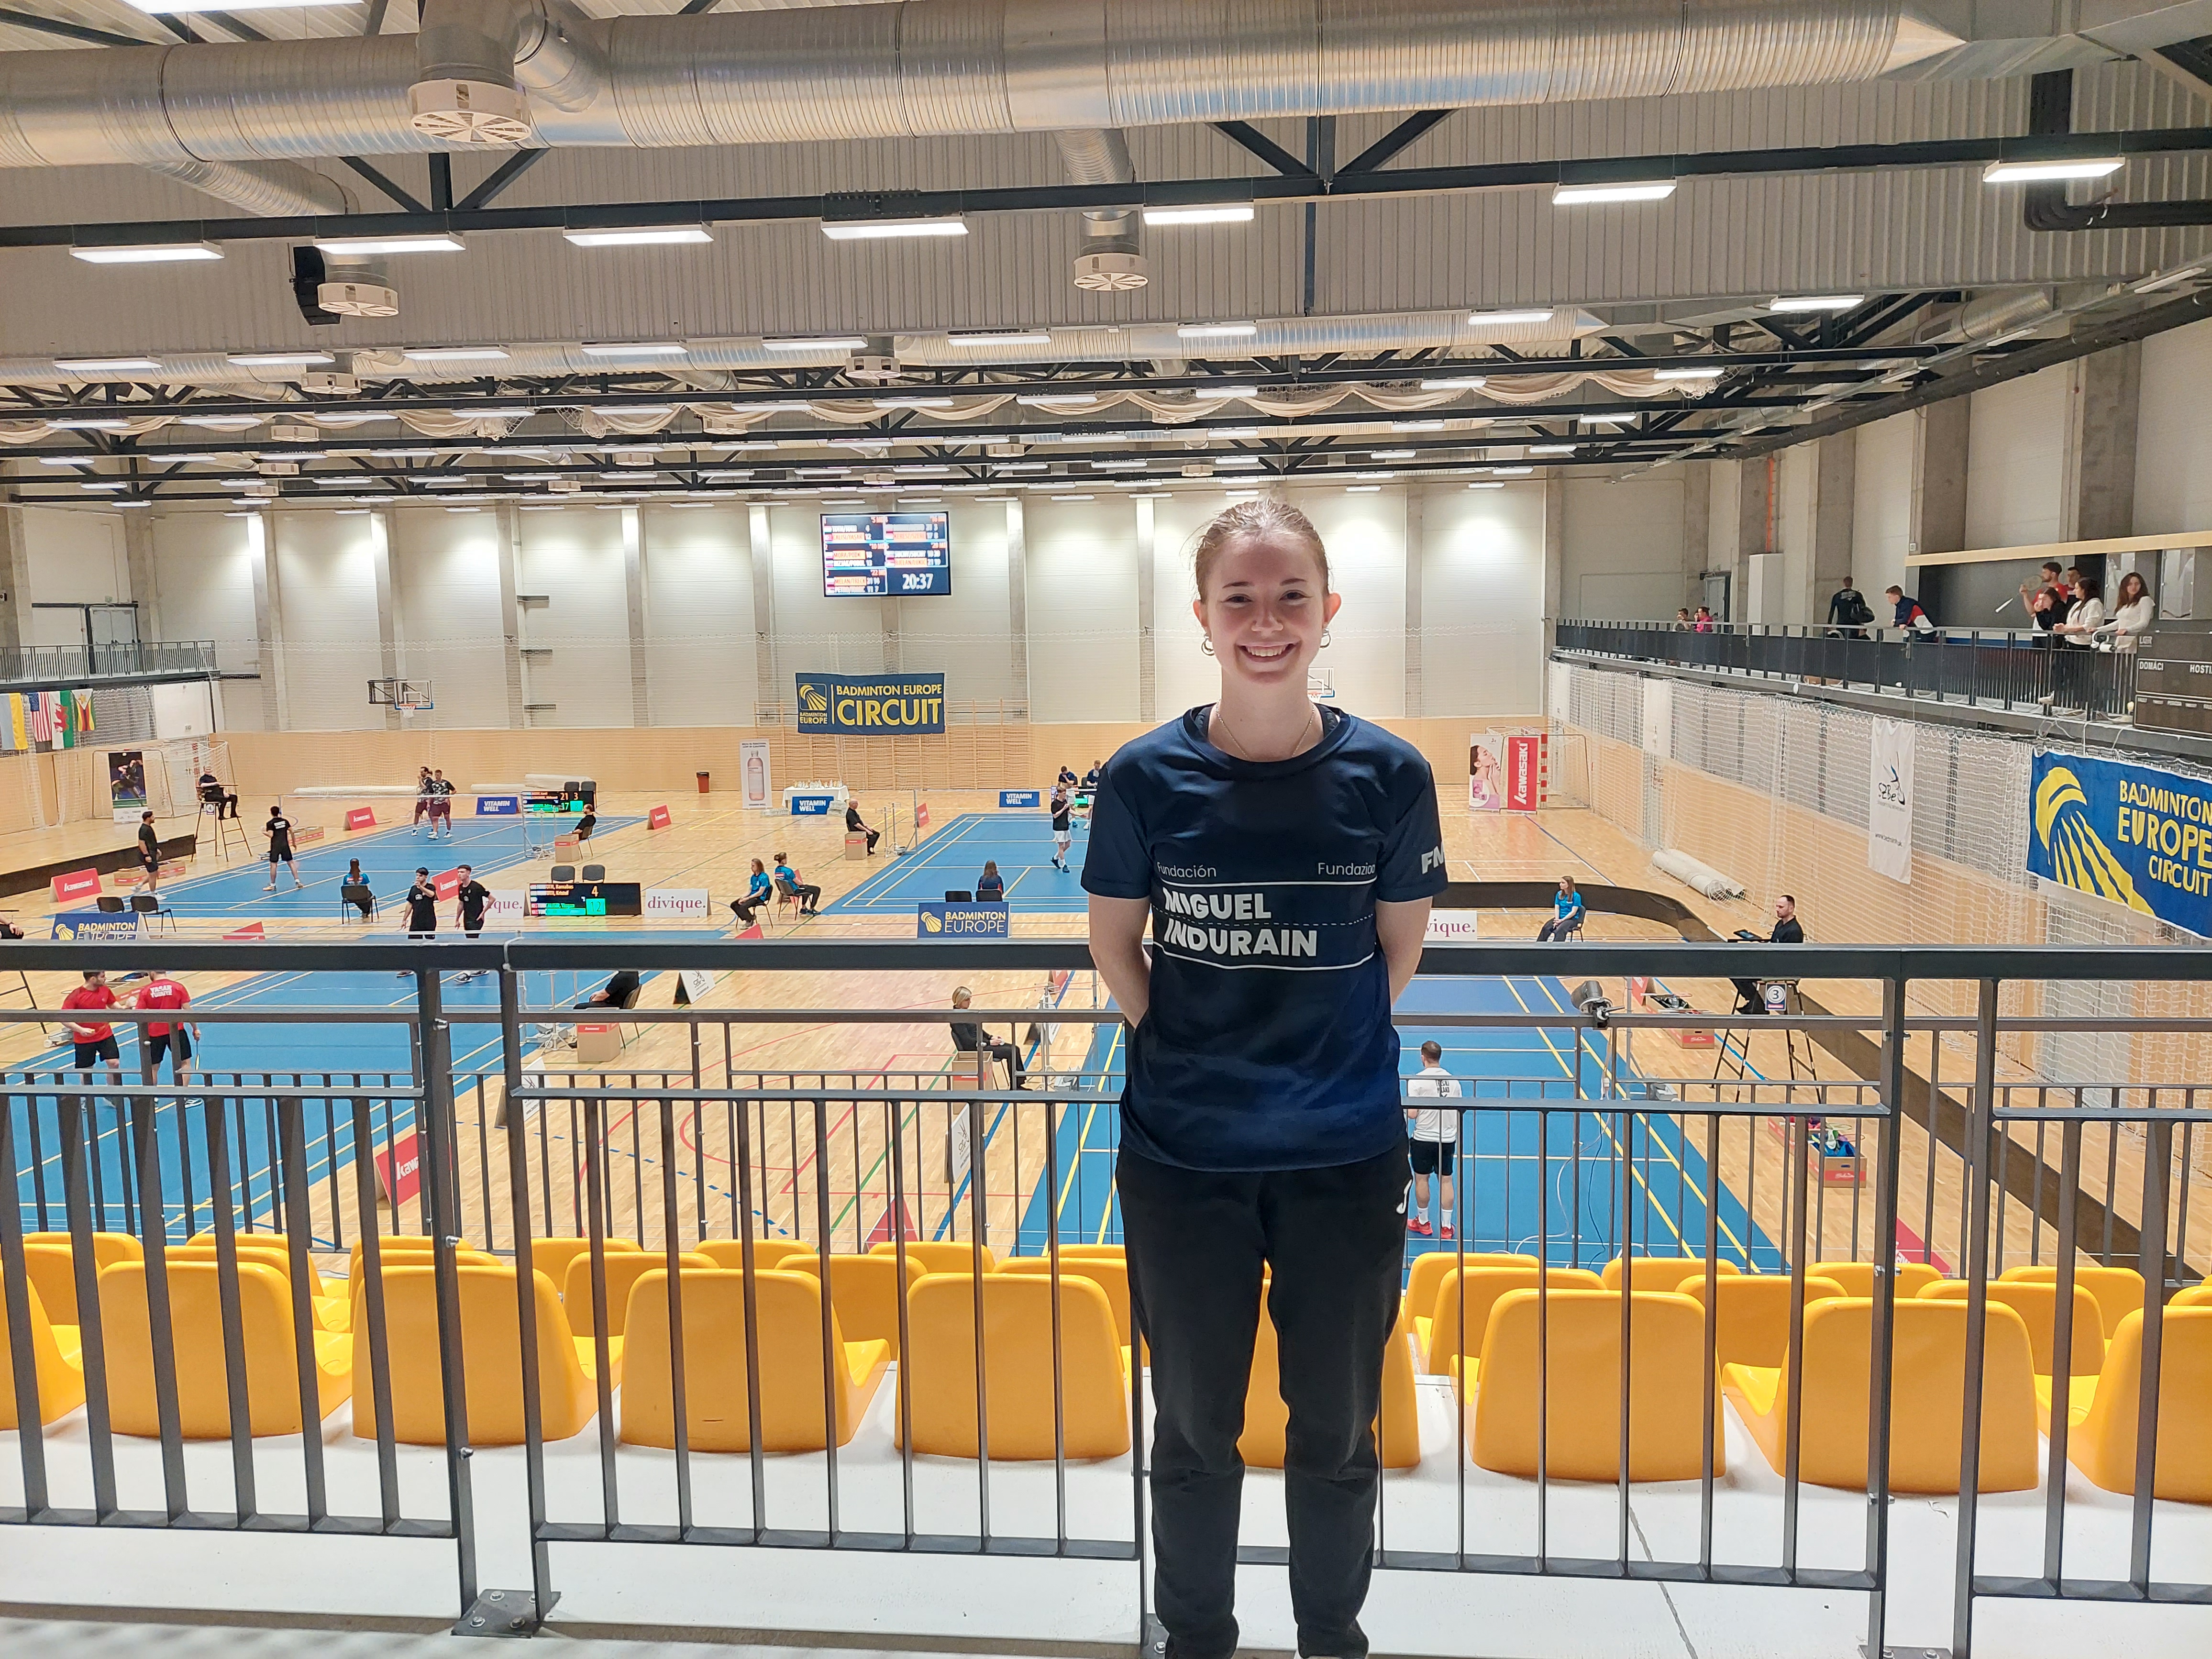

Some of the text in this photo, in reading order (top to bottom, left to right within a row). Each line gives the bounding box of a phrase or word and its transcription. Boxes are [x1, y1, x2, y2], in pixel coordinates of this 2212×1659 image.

[902, 573, 933, 589] 20:37
[2139, 660, 2164, 671] DOMÁCI
[2190, 664, 2212, 674] HOSTI
[837, 684, 942, 696] BADMINTON EUROPE
[837, 698, 942, 726] CIRCUIT
[561, 802, 569, 810] 17
[2120, 780, 2212, 826] BADMINTON
[2118, 807, 2212, 869] EUROPE
[1157, 862, 1217, 878] Fundación
[2149, 855, 2212, 897] CIRCUIT
[591, 886, 598, 897] 4
[591, 901, 601, 912] 12
[648, 896, 706, 913] divique.
[1162, 886, 1272, 920] MIGUEL
[945, 911, 1006, 920] BADMINTON
[78, 922, 136, 931] BADMINTON
[945, 920, 1005, 933] EUROPE
[1427, 918, 1475, 937] vique.
[1164, 918, 1317, 957] INDURAIN
[1772, 990, 1779, 999] 3
